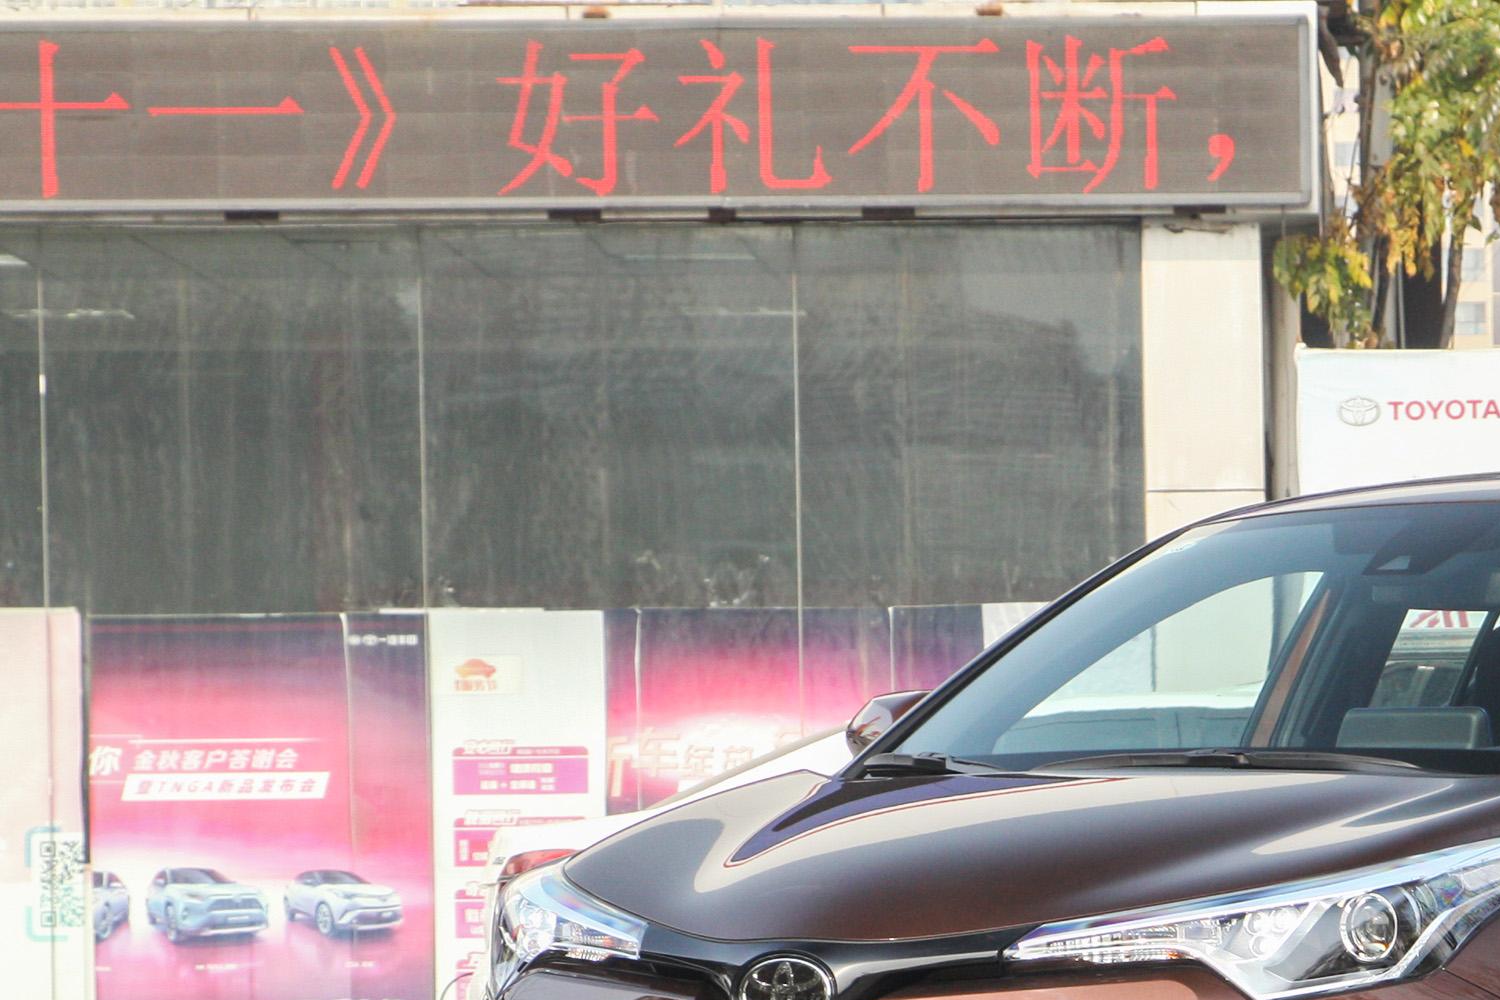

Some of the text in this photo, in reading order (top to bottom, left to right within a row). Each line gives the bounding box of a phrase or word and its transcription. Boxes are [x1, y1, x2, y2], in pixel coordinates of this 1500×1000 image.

[133, 748, 298, 771] 金秋客户答谢会
